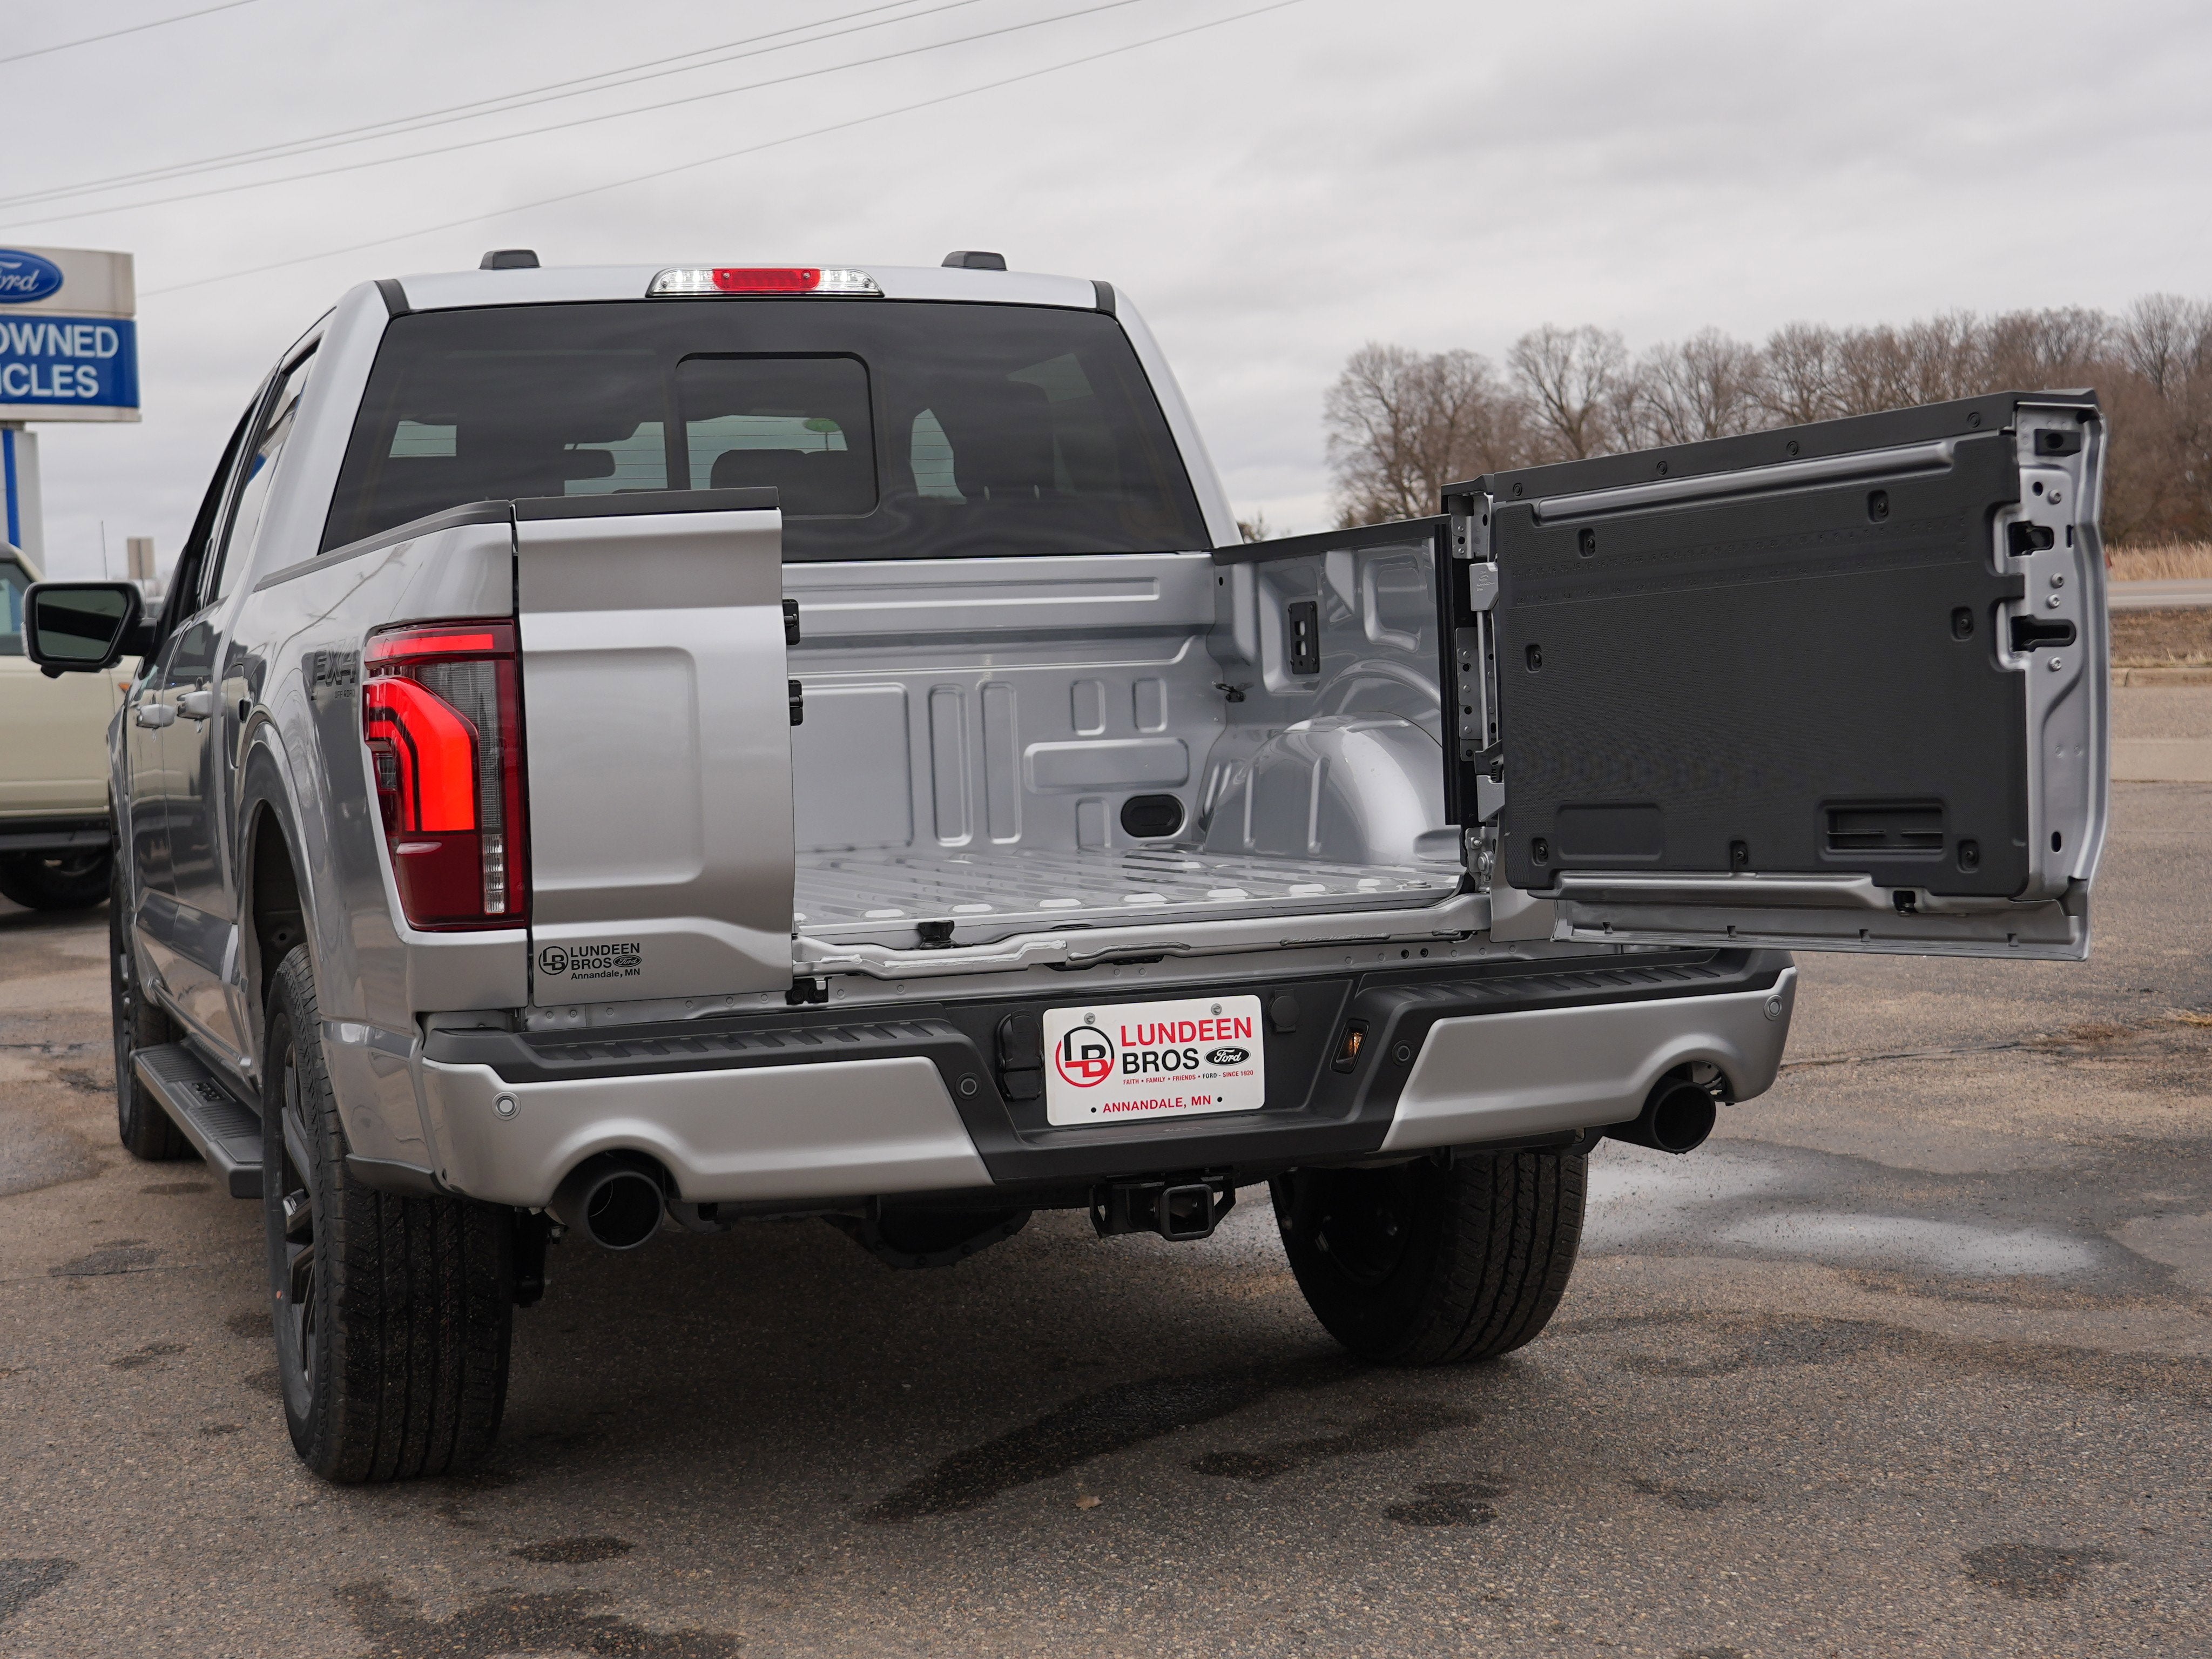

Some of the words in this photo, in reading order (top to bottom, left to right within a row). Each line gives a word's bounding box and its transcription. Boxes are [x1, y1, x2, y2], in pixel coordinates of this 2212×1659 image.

[0, 261, 40, 291] ord
[570, 943, 640, 957] LUNDEEN
[571, 957, 612, 970] BROS
[615, 956, 639, 966] Ford
[570, 970, 623, 980] Annandale,
[1121, 1016, 1252, 1047] LUNDEEN
[1122, 1048, 1199, 1074] BROS
[1210, 1047, 1246, 1064] Ford
[1103, 1097, 1186, 1114] ANNANDALE,
[1191, 1095, 1211, 1107] MN
